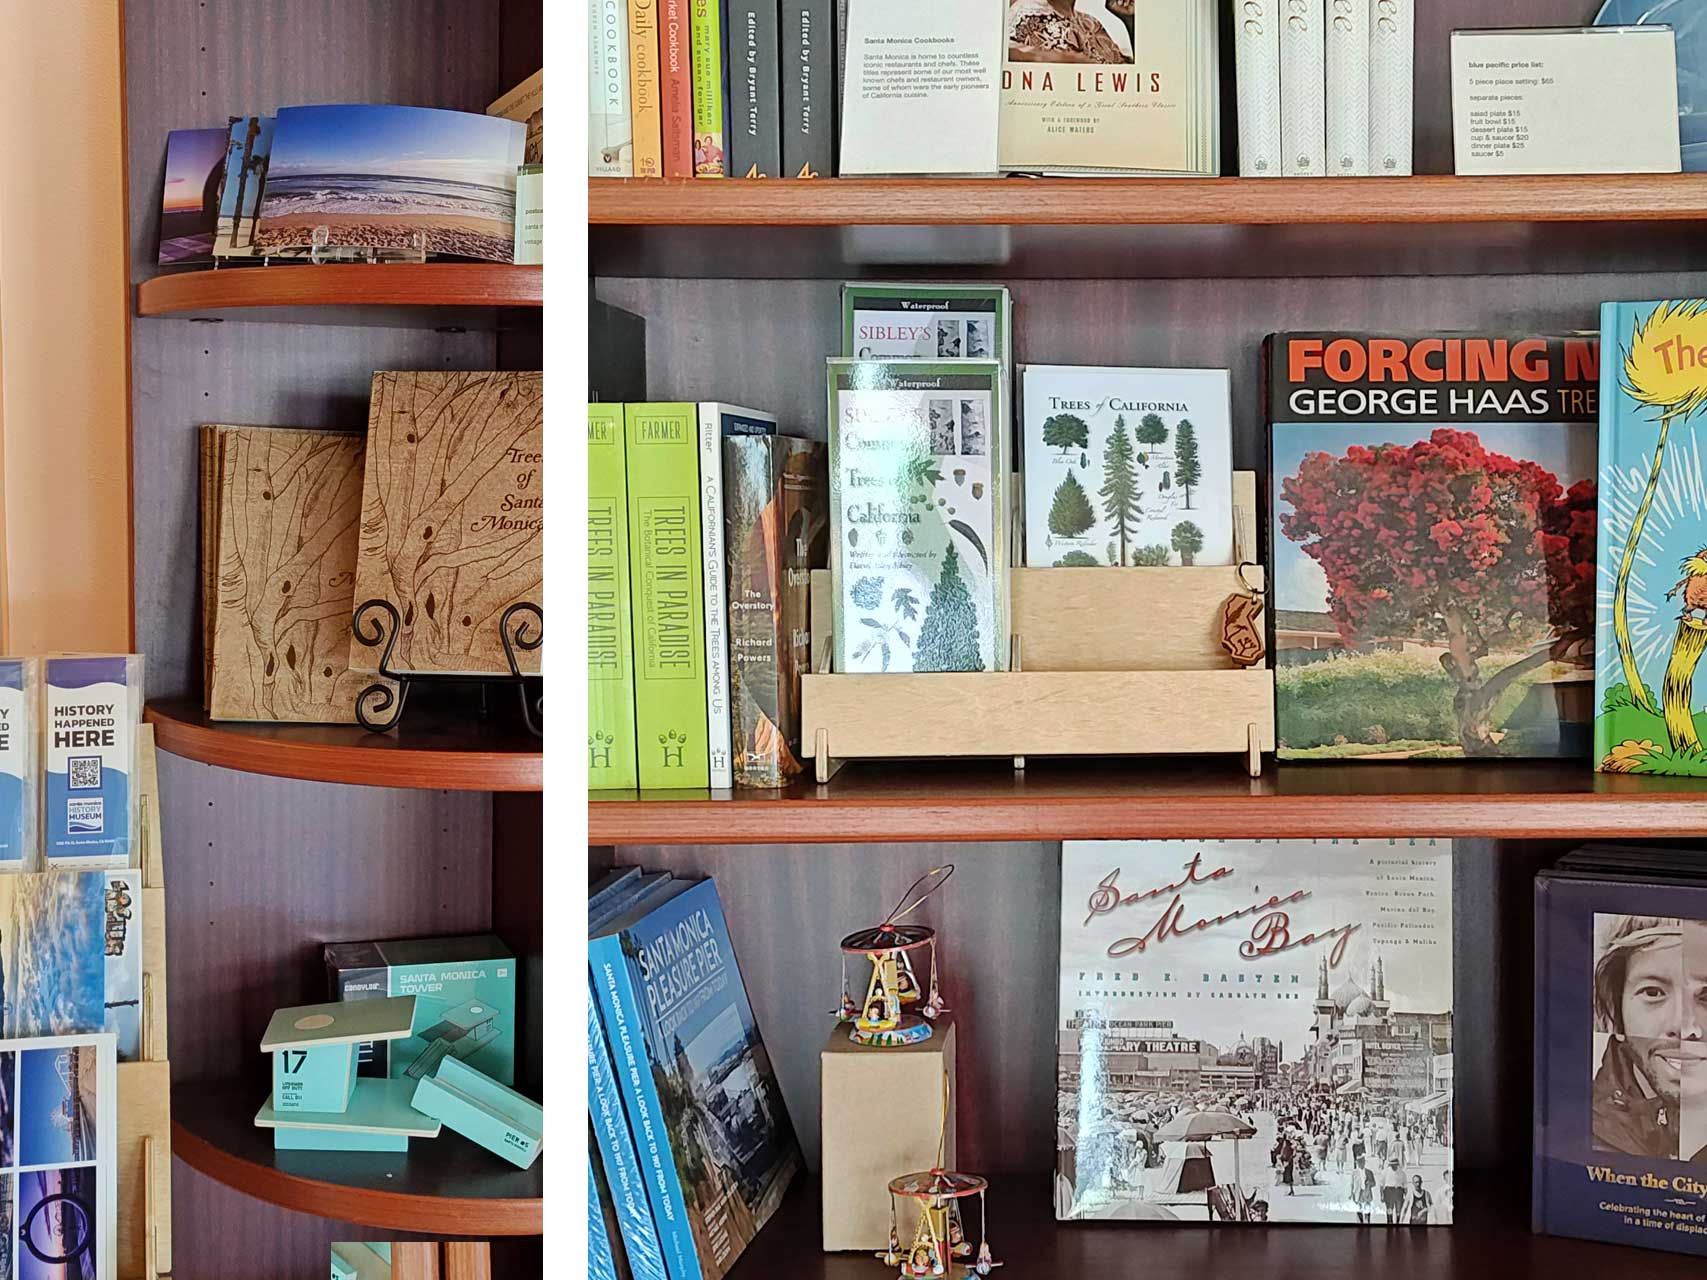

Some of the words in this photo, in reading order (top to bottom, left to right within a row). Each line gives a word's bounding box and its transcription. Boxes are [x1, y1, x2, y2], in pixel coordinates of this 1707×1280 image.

[695, 26, 703, 46] and
[747, 12, 756, 47] Edited
[801, 10, 810, 45] Edited
[668, 22, 680, 73] Cookbook
[864, 37, 885, 45] Santa
[886, 36, 913, 44] Monica
[914, 36, 955, 44] Cookbooks
[605, 1, 619, 105] COOKBOOK
[747, 50, 757, 63] by
[801, 49, 810, 62] by
[881, 69, 912, 77] represent
[1485, 61, 1510, 69] pacific
[636, 44, 653, 113] cookbook
[747, 67, 757, 102] Bryant
[801, 66, 810, 101] Bryant
[863, 76, 885, 84] known
[960, 83, 990, 91] pioneers
[1077, 72, 1160, 93] LEWIS
[1495, 78, 1514, 86] place
[1541, 77, 1554, 85] $65
[748, 106, 758, 136] Terry
[801, 105, 811, 135] Terry
[1489, 110, 1507, 118] plate
[1047, 126, 1066, 134] ALICE
[1497, 126, 1514, 134] plate
[1493, 142, 1511, 150] plate
[900, 300, 950, 311] Waterproof
[859, 325, 931, 341] SIBLEY'S
[1288, 339, 1550, 383] FORCING
[1652, 334, 1707, 375] The
[1048, 396, 1091, 411] TREES
[1090, 395, 1111, 418] of
[1109, 397, 1189, 413] CALIFORNIA
[1289, 388, 1438, 415] GEORGE
[1450, 388, 1550, 415] HAAS
[1557, 389, 1597, 414] TRE
[641, 420, 682, 440] FARMER
[704, 422, 713, 453] Ritter
[516, 468, 537, 490] of
[706, 475, 714, 483] A
[643, 509, 653, 528] The
[653, 505, 687, 556] TREES
[655, 565, 688, 581] IN
[707, 559, 719, 592] GUIDE
[645, 571, 655, 613] Conquest
[709, 593, 718, 606] TO
[744, 589, 762, 598] The
[731, 601, 774, 612] Overstory
[648, 615, 656, 625] of
[709, 609, 719, 626] THE
[656, 590, 691, 669] PARADISE
[647, 627, 657, 668] California
[710, 627, 721, 659] TREES
[735, 637, 773, 647] Richard
[737, 653, 772, 662] Powers
[711, 661, 721, 695] AMONG
[54, 704, 115, 717] HISTORY
[711, 698, 723, 715] US
[54, 718, 115, 729] HAPPENED
[54, 729, 115, 748] HERE
[68, 806, 102, 814] HISTORY
[68, 813, 102, 821] MUSEUM
[1083, 852, 1235, 928] Santa
[1106, 884, 1313, 958] Monica
[638, 932, 675, 982] SANTA
[669, 907, 714, 960] MONICA
[1238, 911, 1362, 970] Bay
[399, 973, 437, 985] SANTA
[440, 970, 487, 982] MONICA
[603, 962, 617, 991] SANTA
[646, 951, 700, 1018] PLEASURE
[695, 937, 723, 978] PIER
[400, 984, 443, 994] TOWER
[610, 990, 625, 1026] MONICA
[619, 1025, 636, 1069] PLEASURE
[1145, 1041, 1197, 1053] THEATRE
[282, 1050, 308, 1074] 17
[635, 1087, 642, 1096] A
[636, 1095, 648, 1119] LOOK
[505, 1131, 520, 1143] PIER
[642, 1118, 656, 1143] BACK
[649, 1141, 658, 1154] TO
[655, 1169, 668, 1195] FROM
[1586, 1165, 1638, 1187] When
[1640, 1173, 1669, 1190] the
[1672, 1176, 1707, 1199] City
[661, 1194, 675, 1222] TODAY
[1598, 1201, 1651, 1217] Celebrating
[1652, 1208, 1668, 1218] the
[1669, 1211, 1694, 1221] heart
[1695, 1215, 1706, 1223] of
[1623, 1216, 1633, 1225] in
[1642, 1218, 1663, 1229] time
[1664, 1221, 1674, 1231] of
[1675, 1223, 1707, 1235] displac
